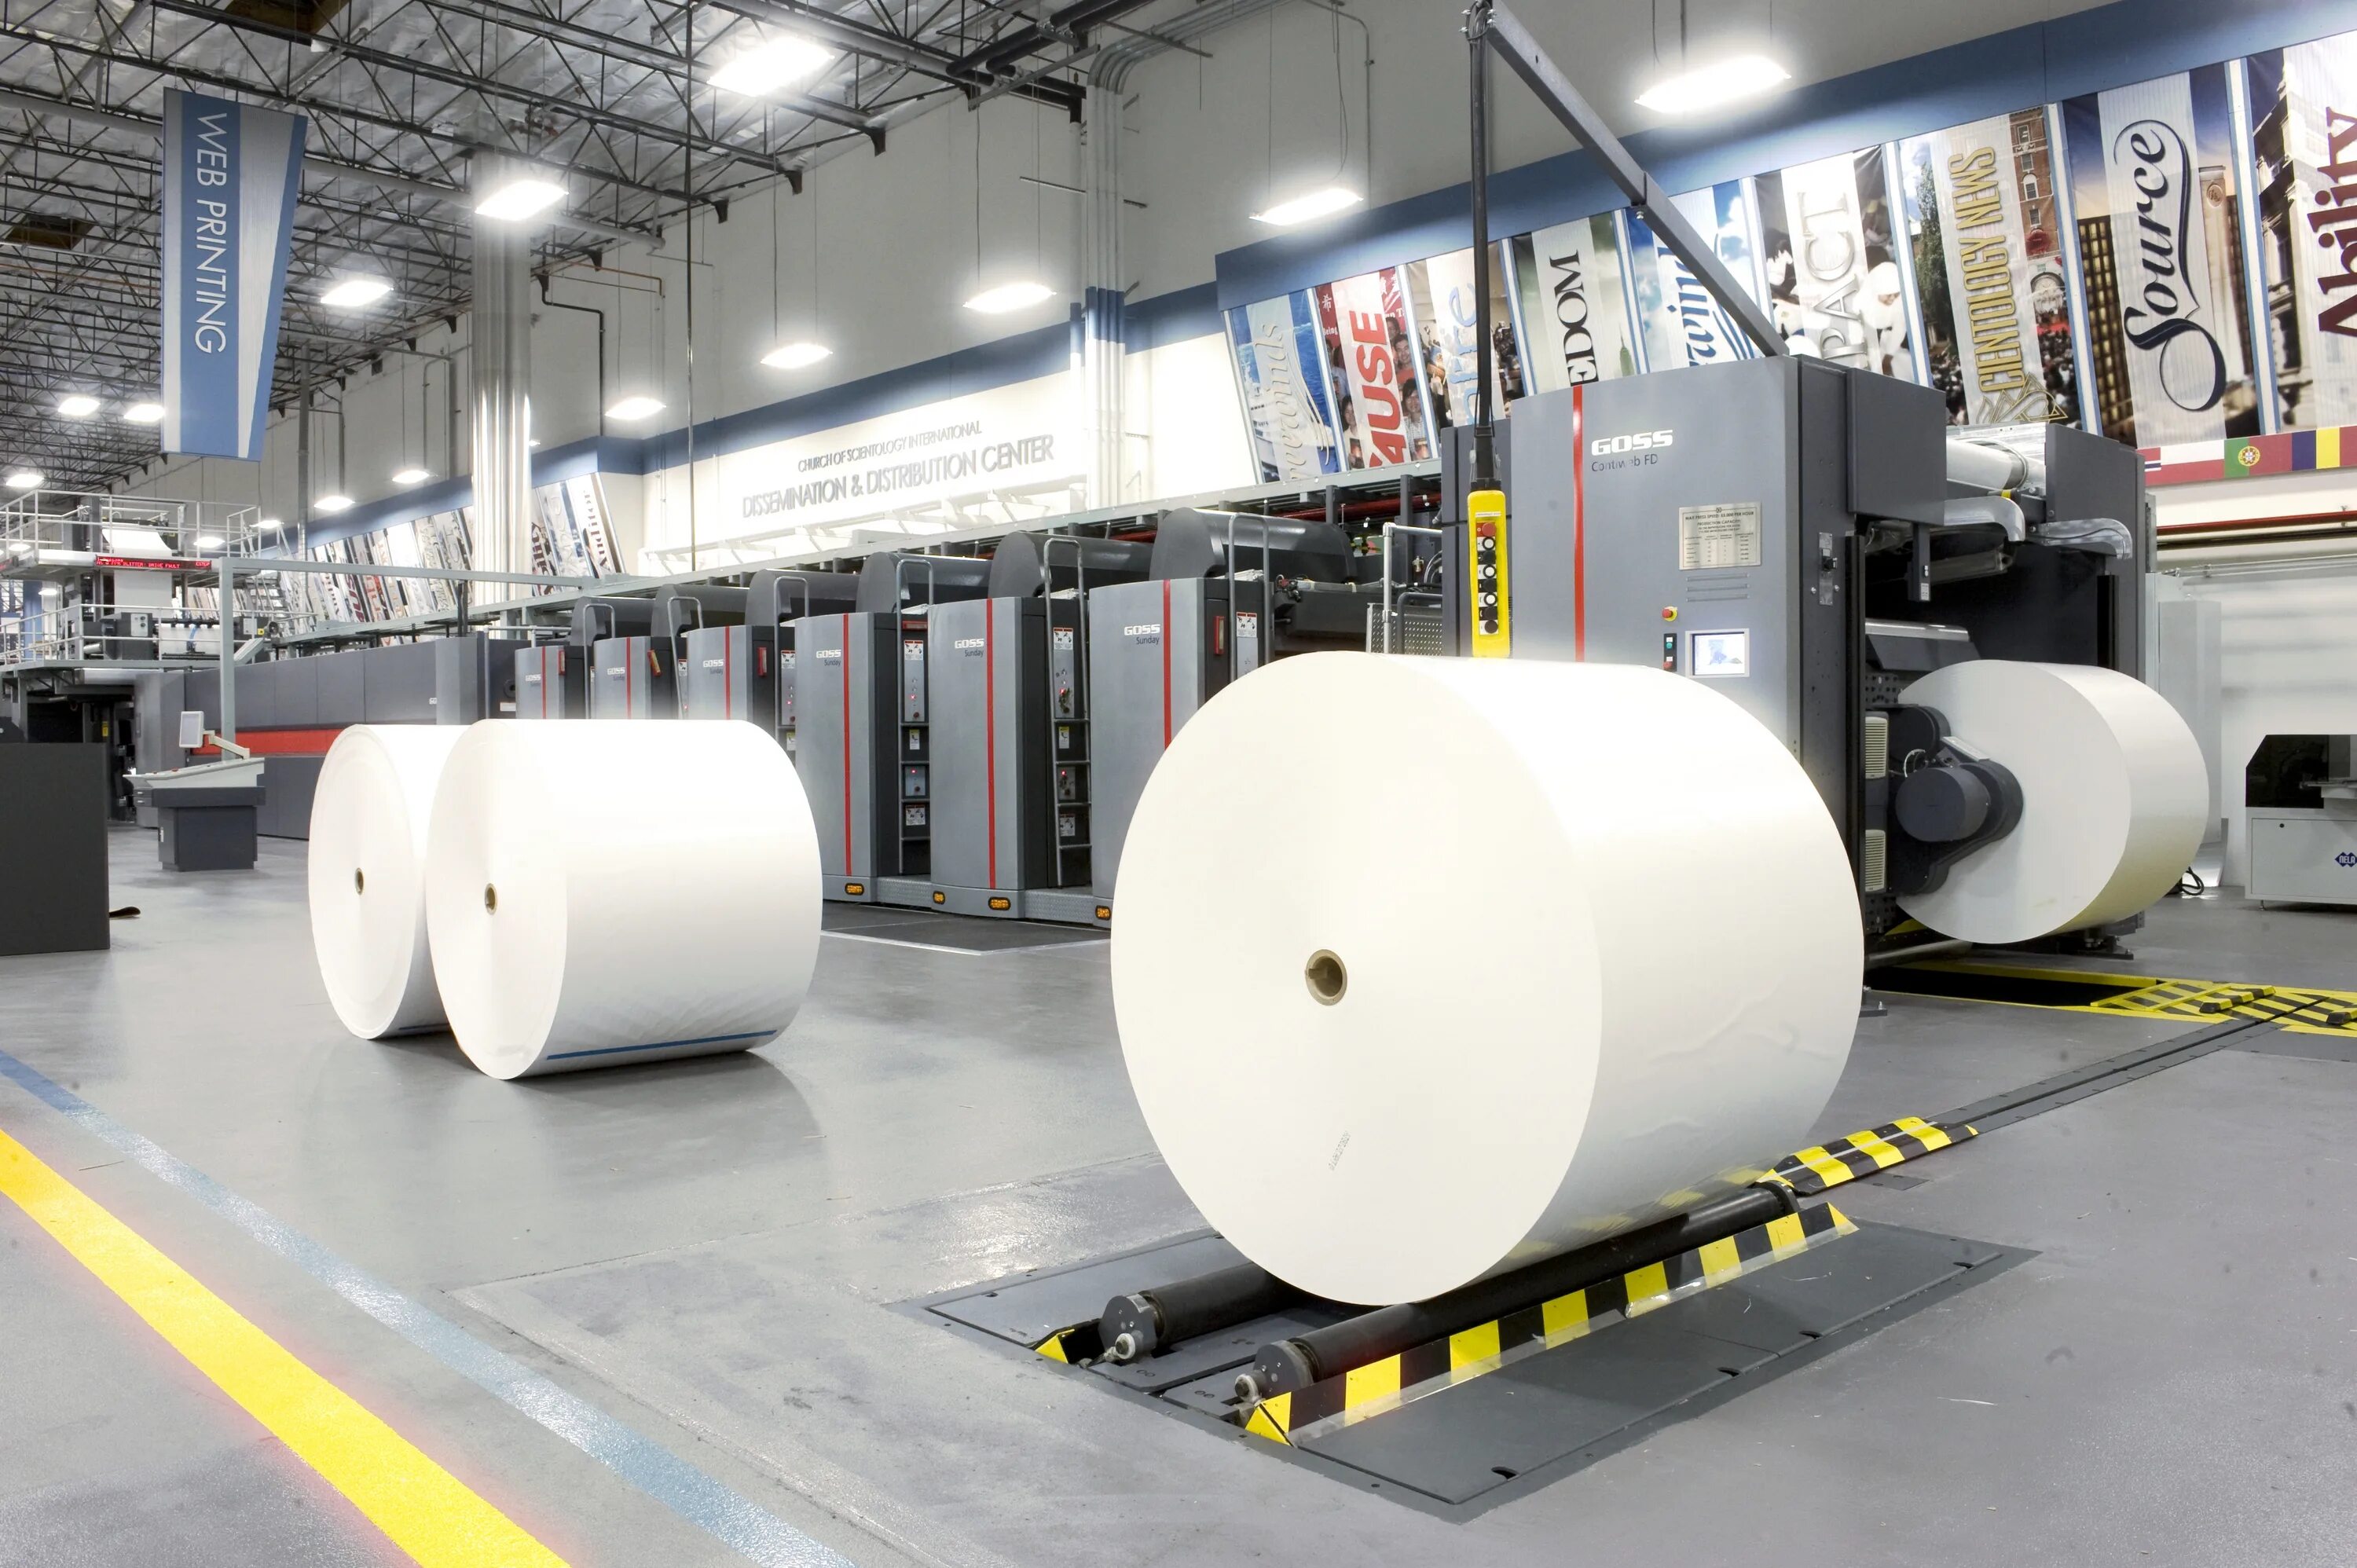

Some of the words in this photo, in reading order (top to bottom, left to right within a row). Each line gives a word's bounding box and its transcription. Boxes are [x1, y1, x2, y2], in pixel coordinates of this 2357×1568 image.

[196, 112, 227, 186] WEB
[1948, 147, 2003, 229] NEWS
[195, 199, 227, 354] PRINTING
[1797, 191, 1871, 371] PACT
[2113, 119, 2226, 412] Source
[1349, 310, 1406, 467] AUSE
[797, 449, 833, 472] CHURCH
[833, 450, 846, 465] OF
[847, 437, 907, 461] SCIENTOLOGY
[908, 420, 982, 449] INTERNATIONAL
[1592, 430, 1673, 456] GOSS
[1644, 453, 1659, 465] FD
[742, 478, 847, 518] DISSEMINATION
[851, 474, 863, 497] &
[867, 450, 977, 494] DISTRIBUTION
[981, 434, 1054, 472] CENTER
[954, 638, 984, 649] GOSS
[1124, 624, 1160, 636] GOSS
[1136, 636, 1160, 645] Sunday
[703, 658, 724, 668] GOSS
[816, 649, 841, 658] GOSS
[964, 649, 984, 658] Sunday
